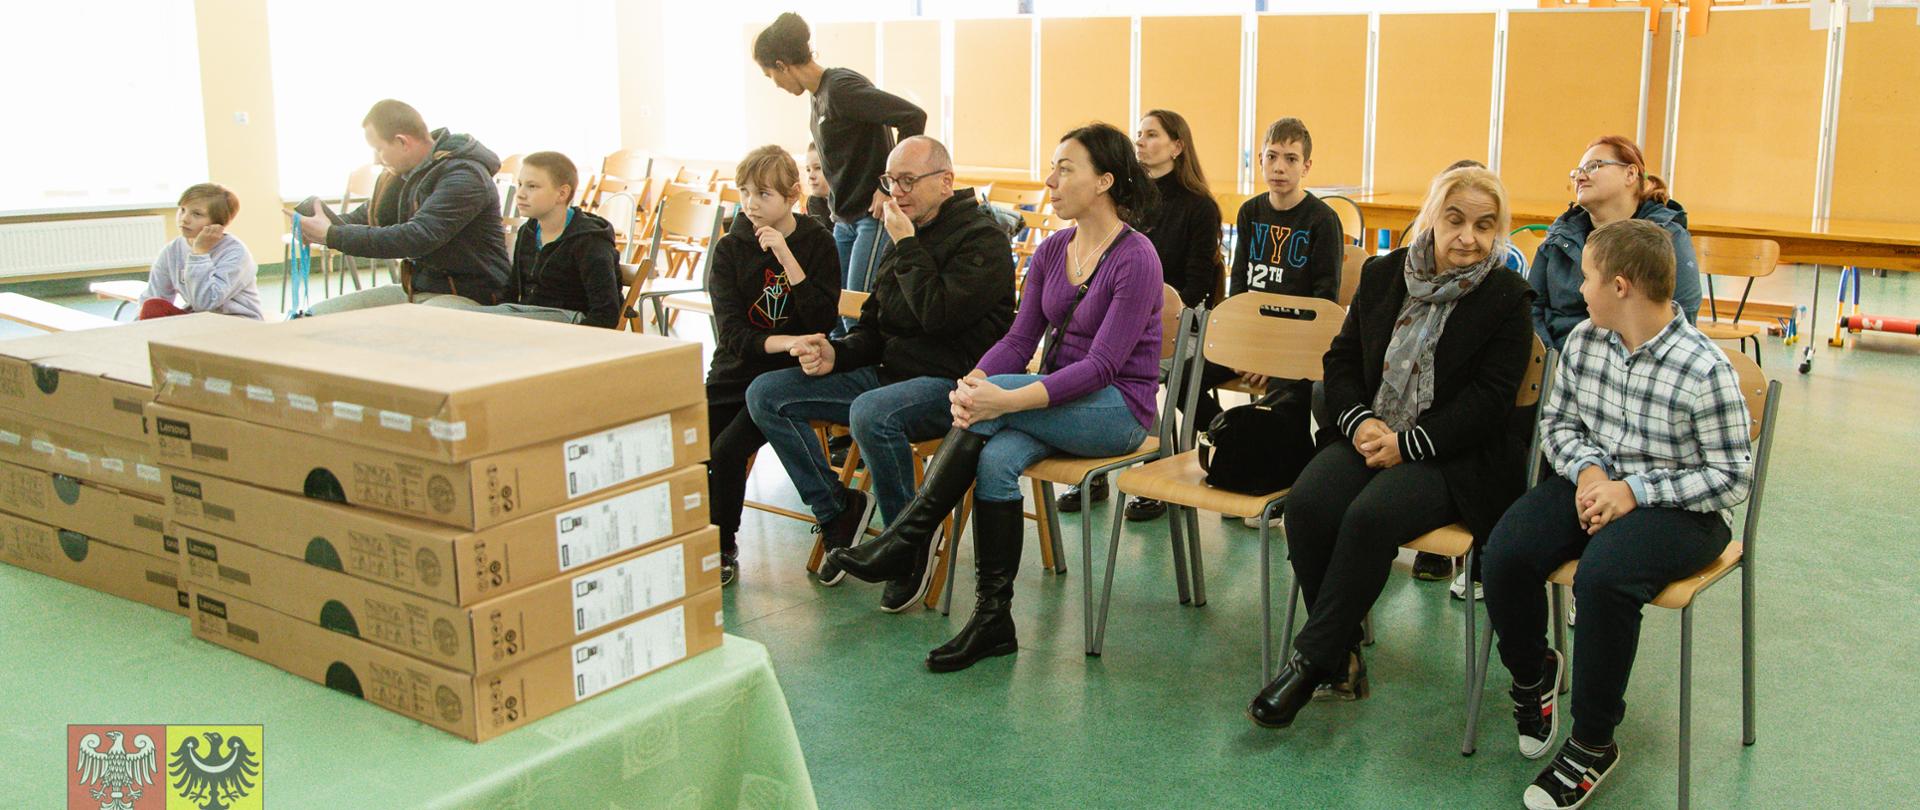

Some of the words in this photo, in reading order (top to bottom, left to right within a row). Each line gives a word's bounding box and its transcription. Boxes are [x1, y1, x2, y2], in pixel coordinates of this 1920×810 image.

[1249, 221, 1310, 268] NYC
[158, 421, 188, 436] Lenovo
[173, 480, 200, 496] Lenovo
[188, 541, 217, 559] Lenovo
